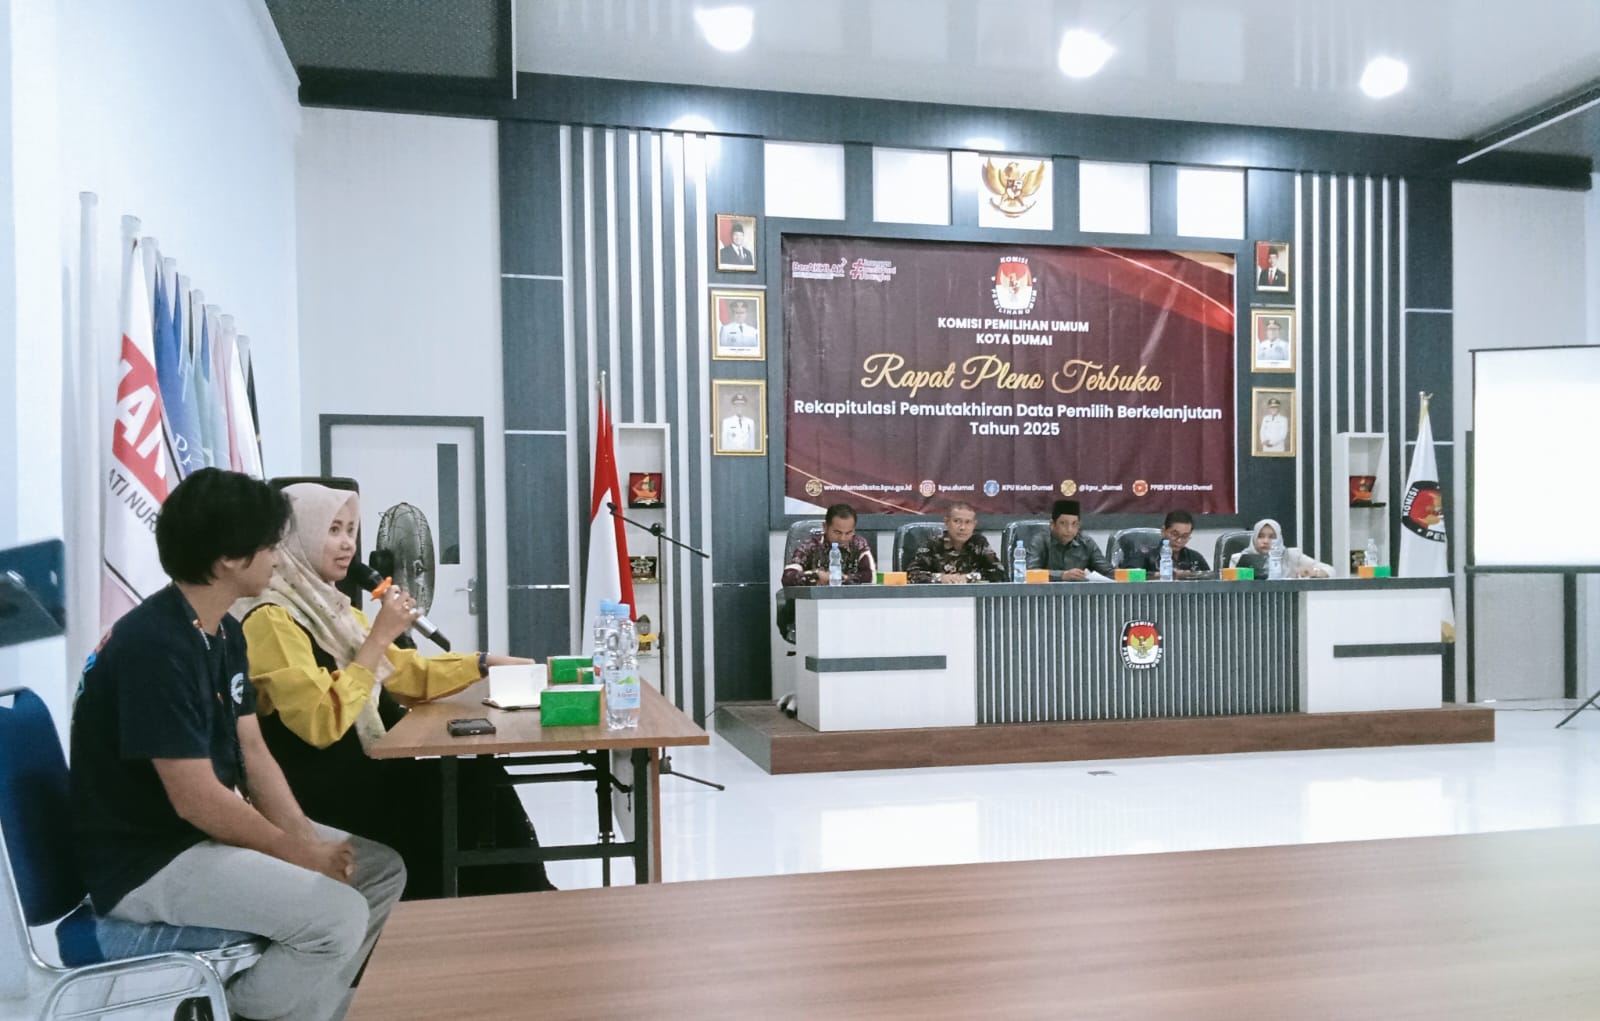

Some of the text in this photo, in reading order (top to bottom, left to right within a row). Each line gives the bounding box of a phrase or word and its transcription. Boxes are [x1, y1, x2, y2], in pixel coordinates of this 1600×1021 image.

[1000, 256, 1029, 265] KOMISI
[937, 317, 1089, 332] KOMISI PEMILIHAN UMUM
[976, 333, 1053, 346] KOTA DUMAI
[860, 353, 1162, 398] Rapat Pleno Terbuka
[794, 400, 1222, 423] Rekapitulasi Pemutakhiran Data Pemilih Berkelanjutan
[969, 421, 1060, 436] Tahun 2025
